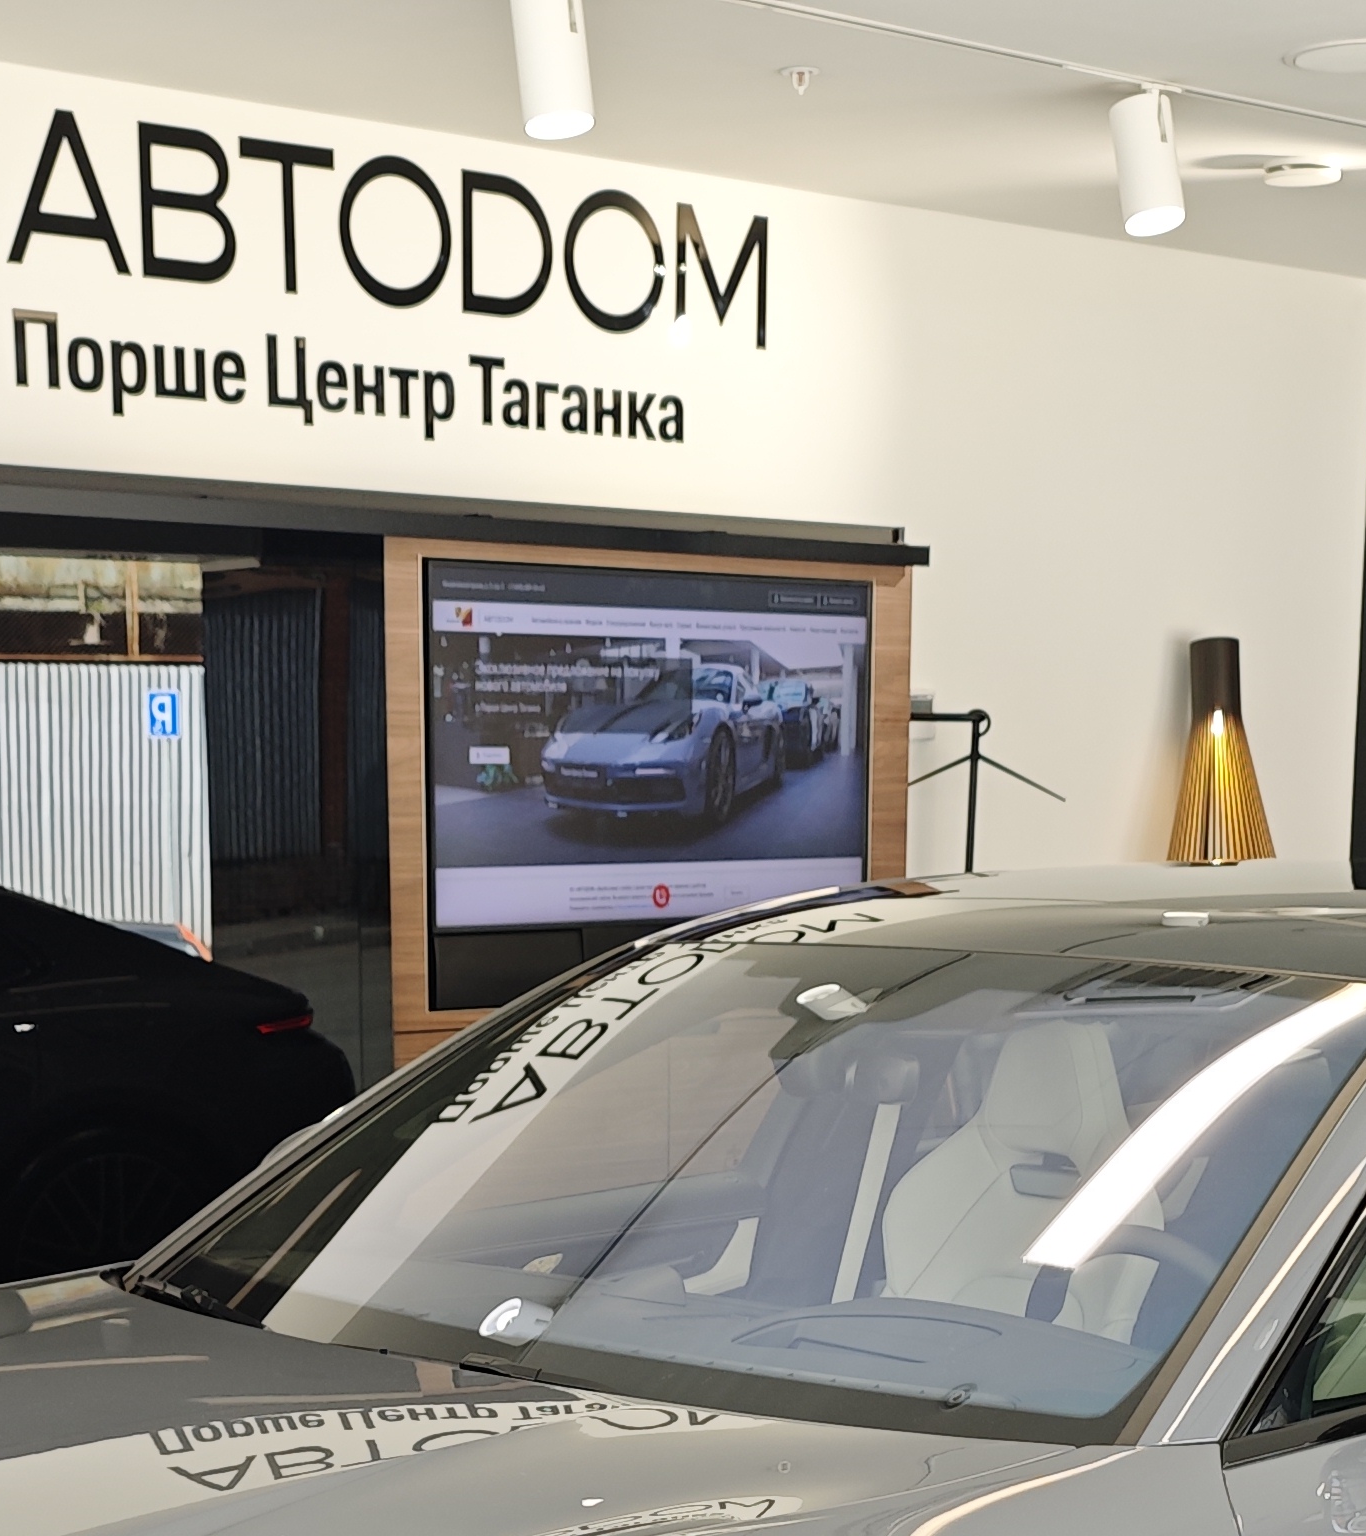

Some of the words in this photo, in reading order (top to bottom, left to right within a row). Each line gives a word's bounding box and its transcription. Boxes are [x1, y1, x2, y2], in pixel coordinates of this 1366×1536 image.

[11, 307, 247, 416] Порше
[265, 332, 456, 442] Центр
[468, 353, 686, 444] Таганка
